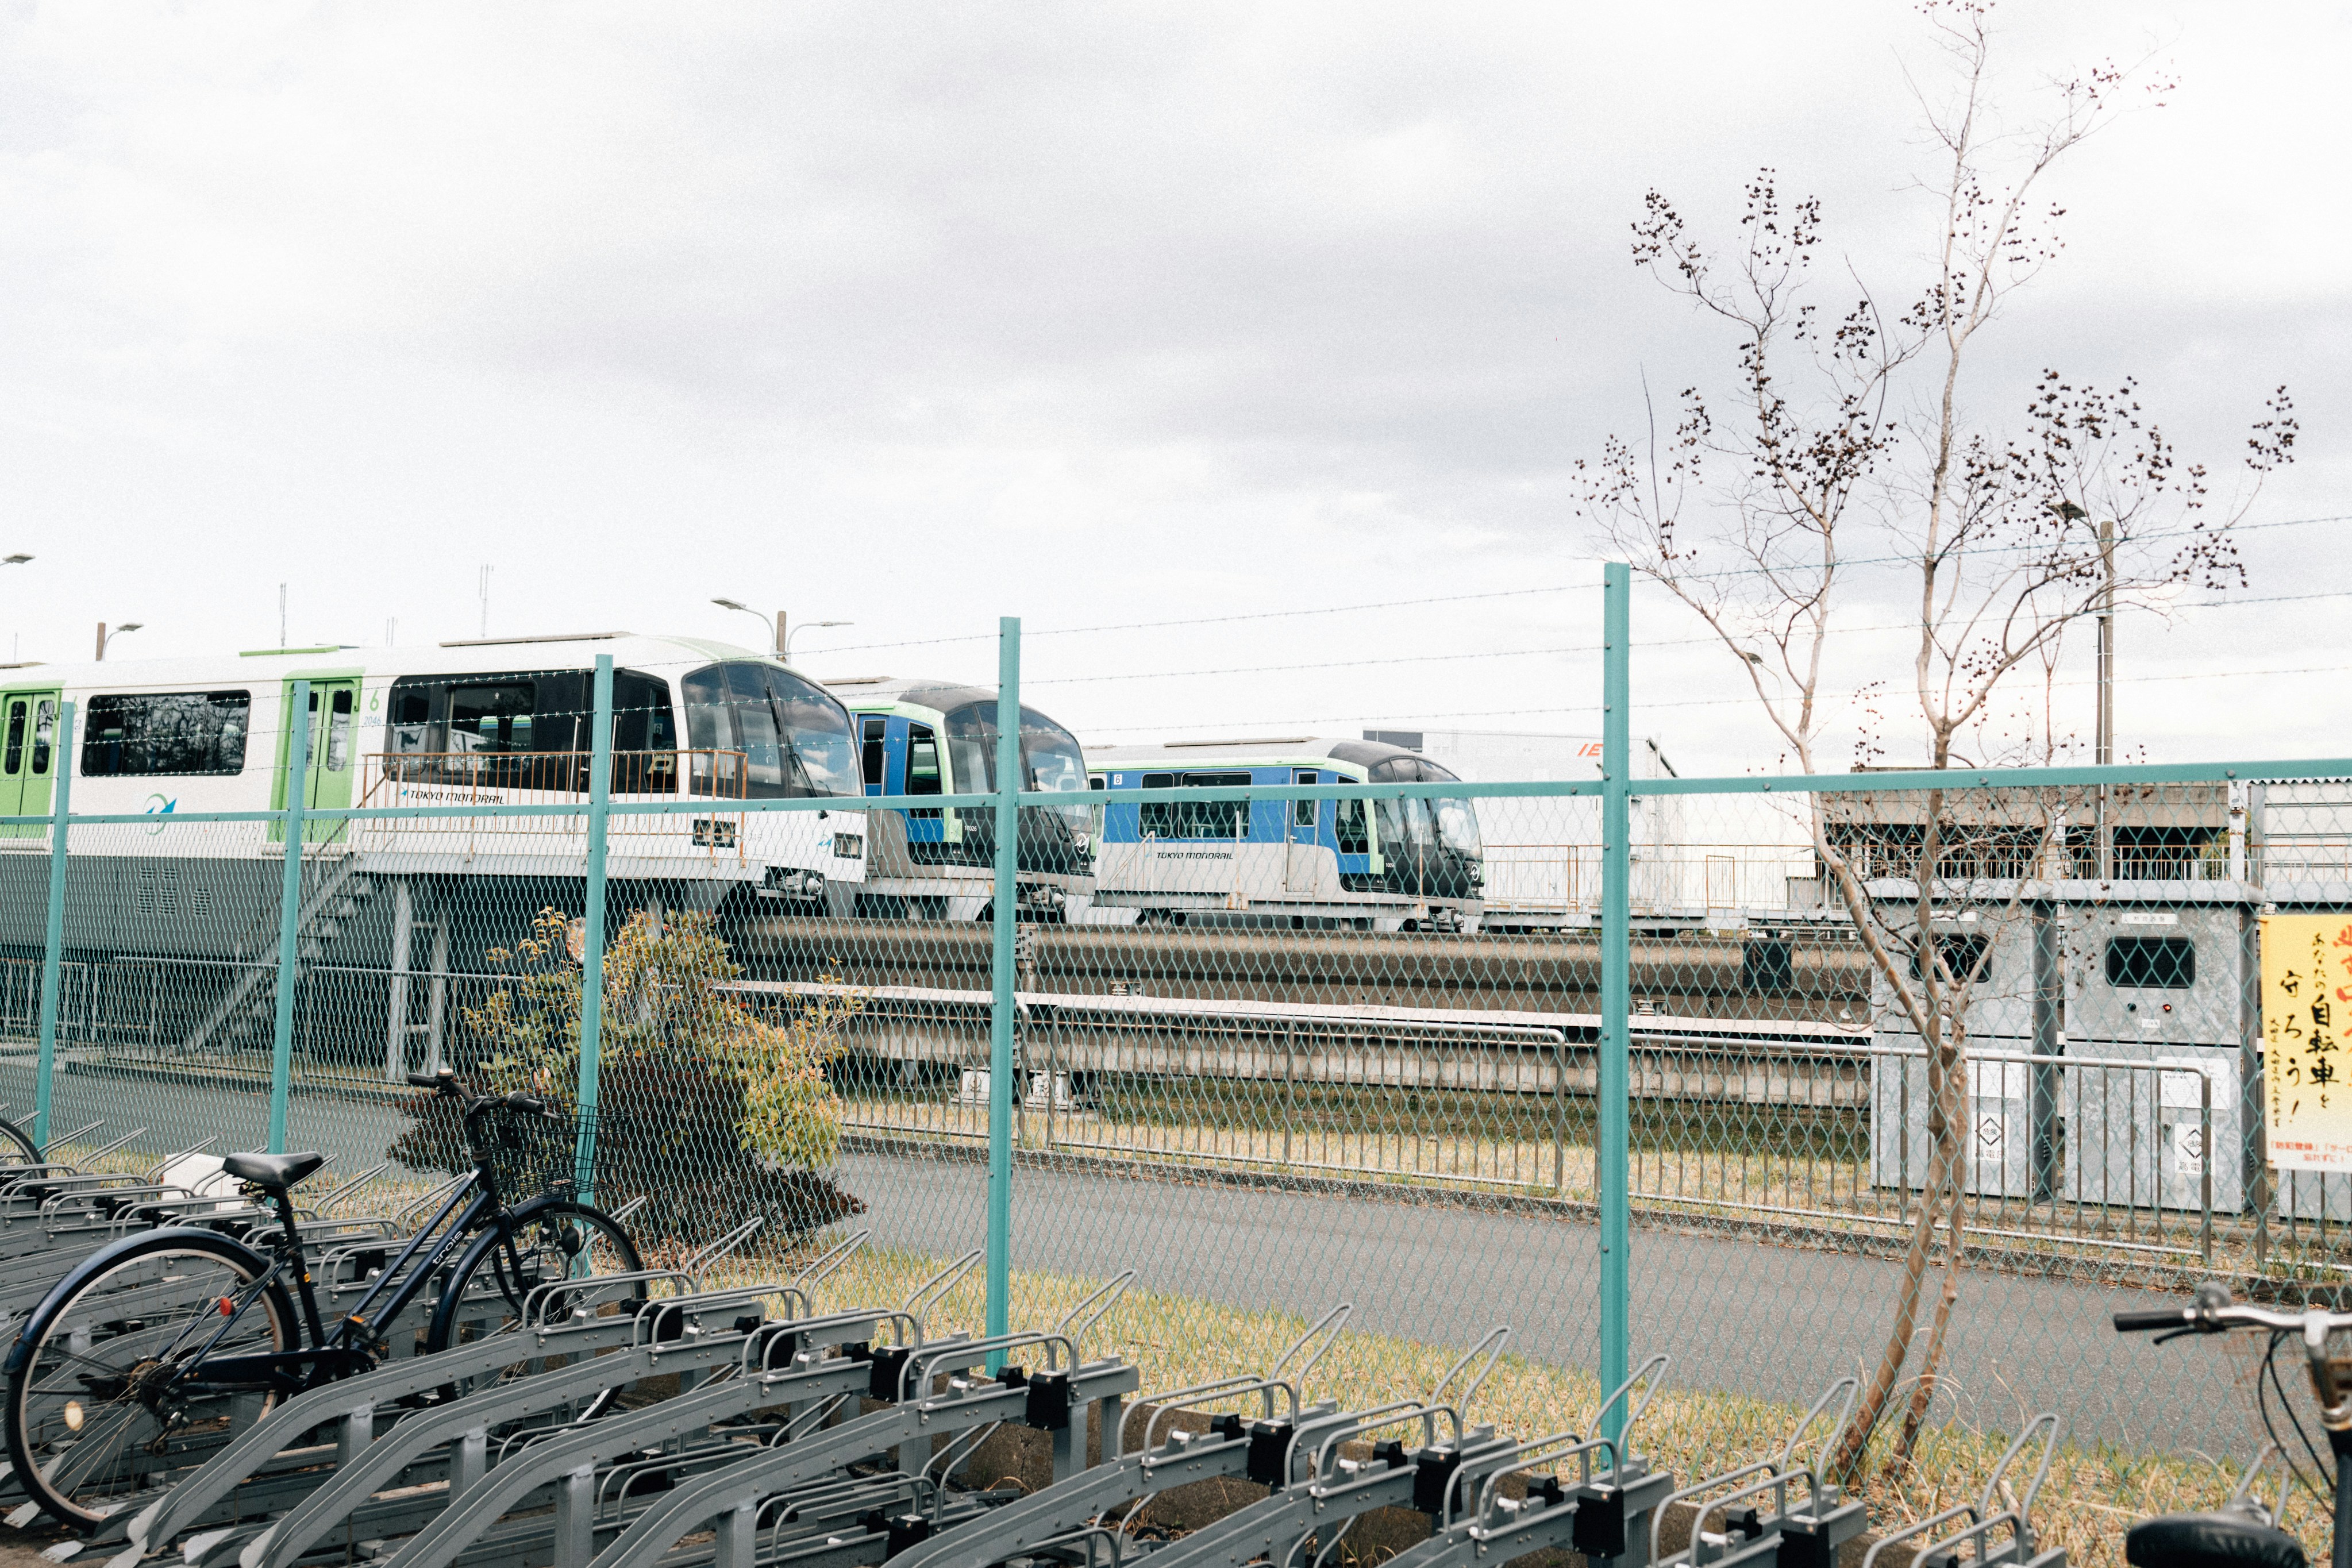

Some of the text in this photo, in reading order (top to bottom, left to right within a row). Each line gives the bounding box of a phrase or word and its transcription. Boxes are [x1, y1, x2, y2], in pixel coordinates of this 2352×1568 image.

[369, 689, 379, 711] 6
[363, 716, 382, 725] 2046
[655, 724, 661, 734] 6
[1115, 775, 1121, 784] 6
[410, 790, 505, 804] TOKYO MONORAIL
[2305, 932, 2339, 1108] あなたの自転車を
[1983, 1128, 1997, 1136] 危険
[432, 1230, 463, 1264] trois
